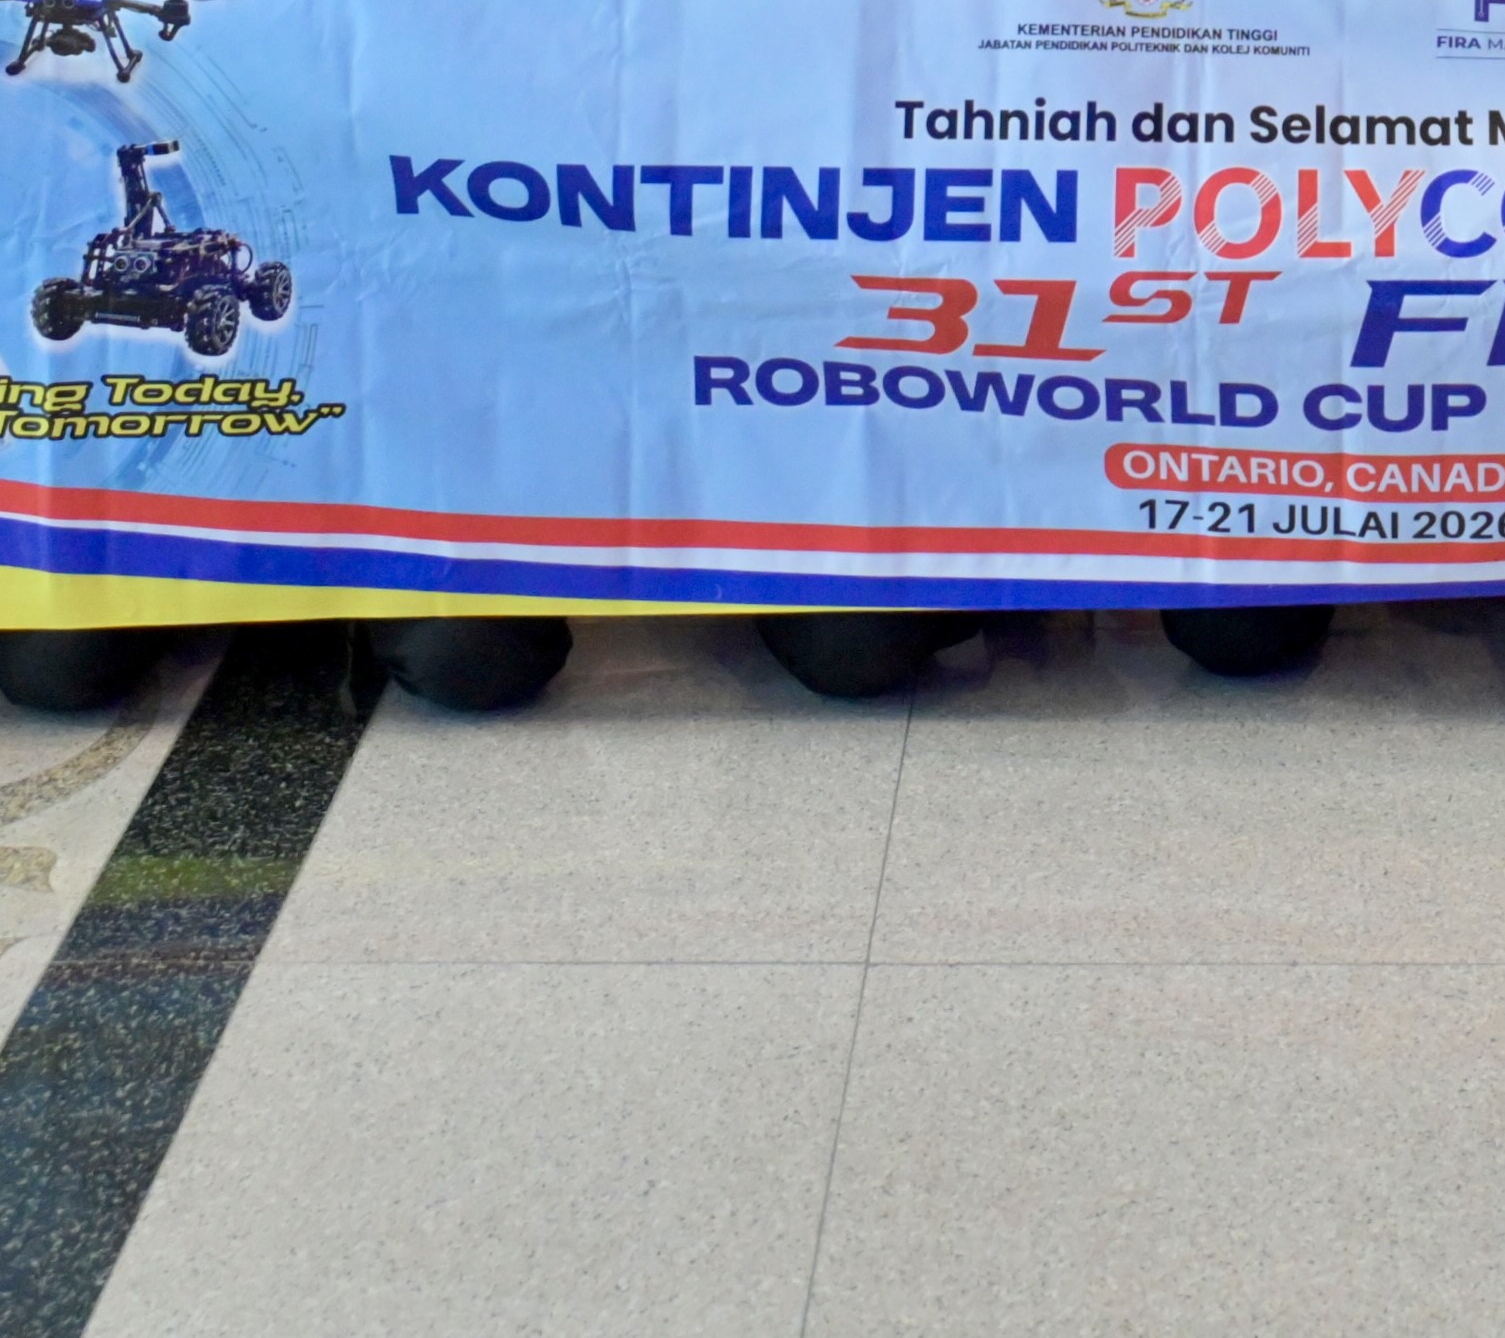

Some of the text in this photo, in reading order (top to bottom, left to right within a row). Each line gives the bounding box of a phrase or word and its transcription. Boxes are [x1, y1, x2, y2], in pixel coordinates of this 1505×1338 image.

[978, 39, 1311, 57] JABATAN PENDIDIKAN POLITEKNIK DAN KOLEJ KOMUNITI
[1017, 23, 1278, 42] KEMENTERIAN PENDIDIKAN TINGGI
[1436, 35, 1482, 50] FIRA
[895, 97, 1116, 142] Tahniah
[1130, 102, 1235, 144] dan
[1249, 105, 1473, 146] Selamat
[389, 154, 1078, 243] KONTINJEN
[693, 355, 1281, 430] ROBOWORLD
[1301, 383, 1487, 432] CUP
[1121, 448, 1337, 496] ONTARIO,
[1137, 500, 1259, 536] 17-21
[1273, 502, 1401, 540] JULAI
